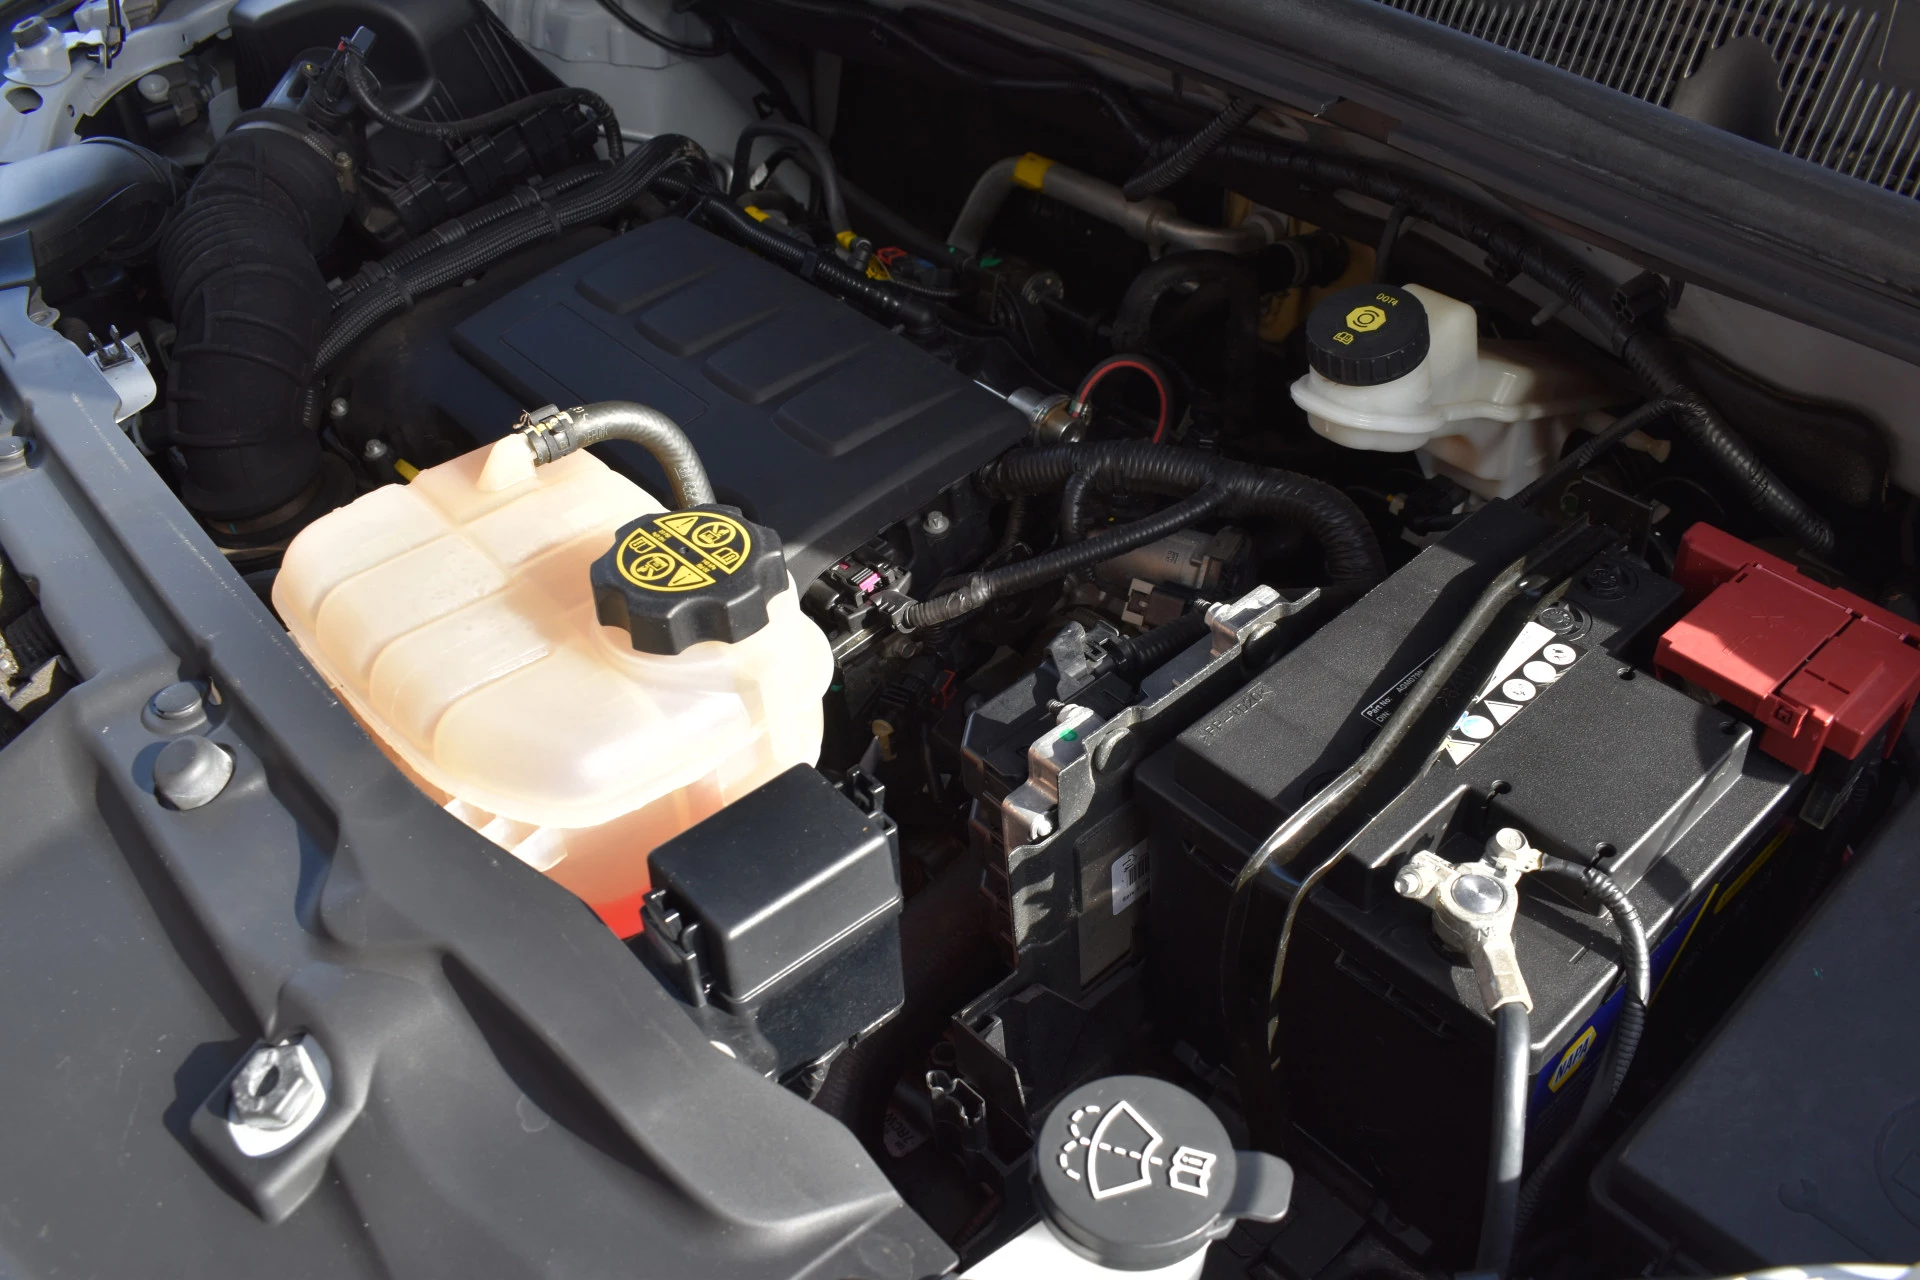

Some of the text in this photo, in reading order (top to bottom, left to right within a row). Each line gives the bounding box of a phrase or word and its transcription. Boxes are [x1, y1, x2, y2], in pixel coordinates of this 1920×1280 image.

[1375, 292, 1399, 306] DOT4
[1366, 703, 1383, 717] Part
[1379, 696, 1393, 708] No:
[1375, 710, 1392, 723] DIN:
[1552, 1035, 1591, 1086] NAPA
